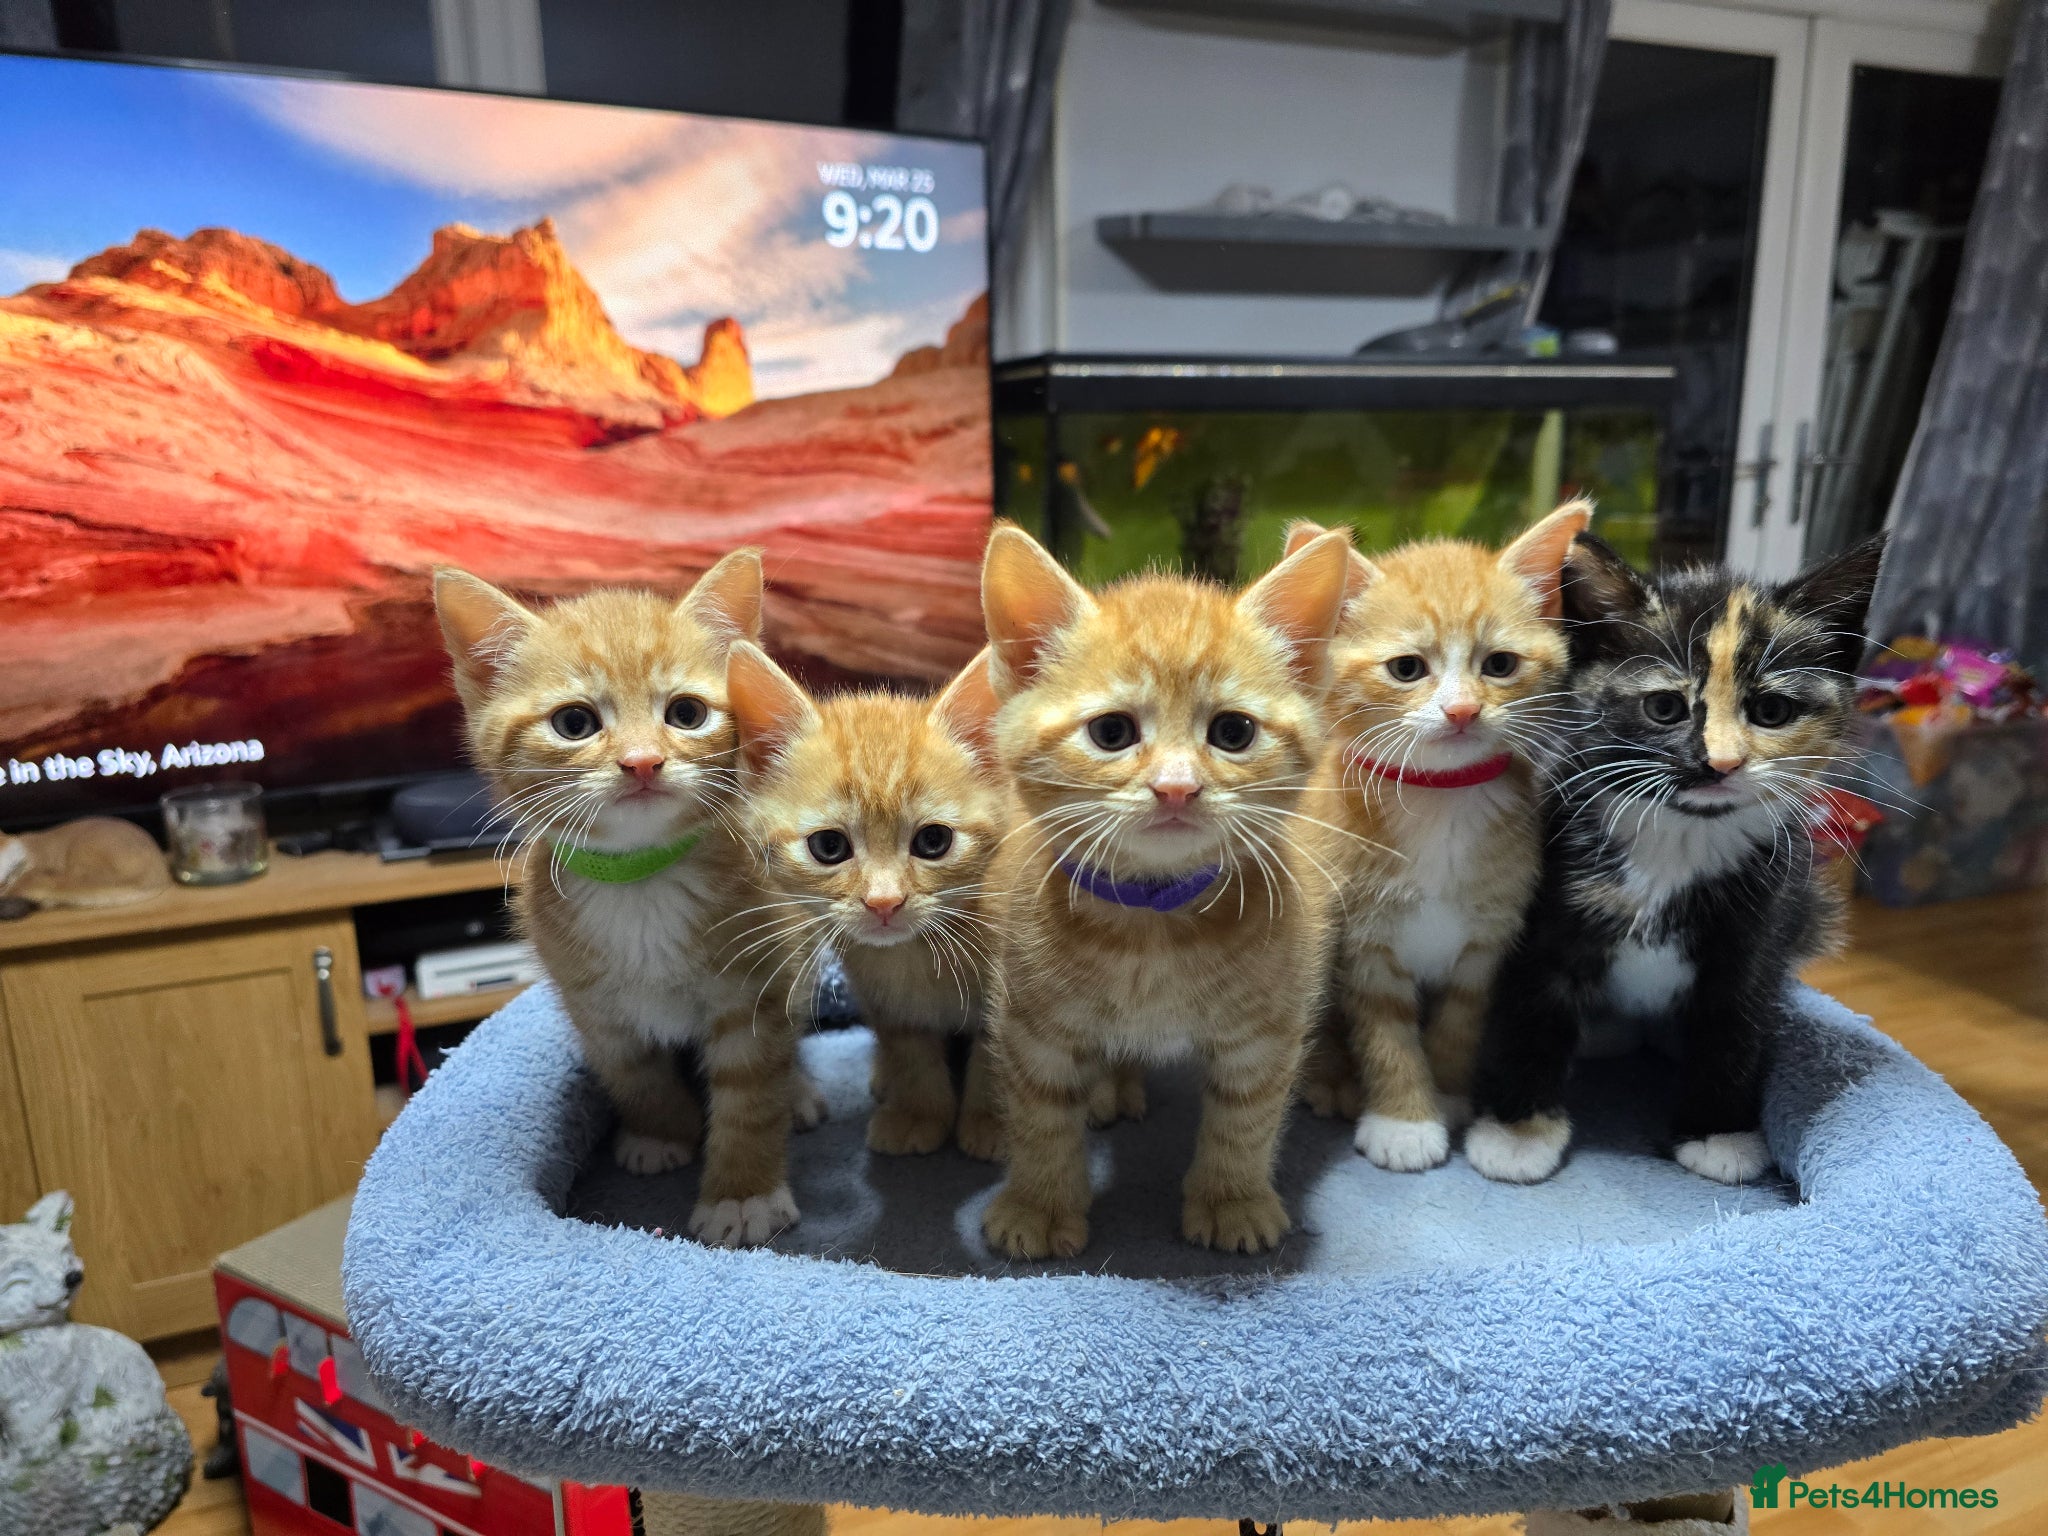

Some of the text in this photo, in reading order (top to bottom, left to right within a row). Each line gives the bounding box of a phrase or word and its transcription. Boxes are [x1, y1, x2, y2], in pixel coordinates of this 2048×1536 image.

[817, 162, 867, 191] WED,
[867, 165, 909, 192] MAR
[822, 190, 939, 253] 9:20
[9, 758, 41, 785] in
[43, 753, 96, 781] the
[96, 747, 157, 778] Sky,
[161, 739, 266, 770] Arizona
